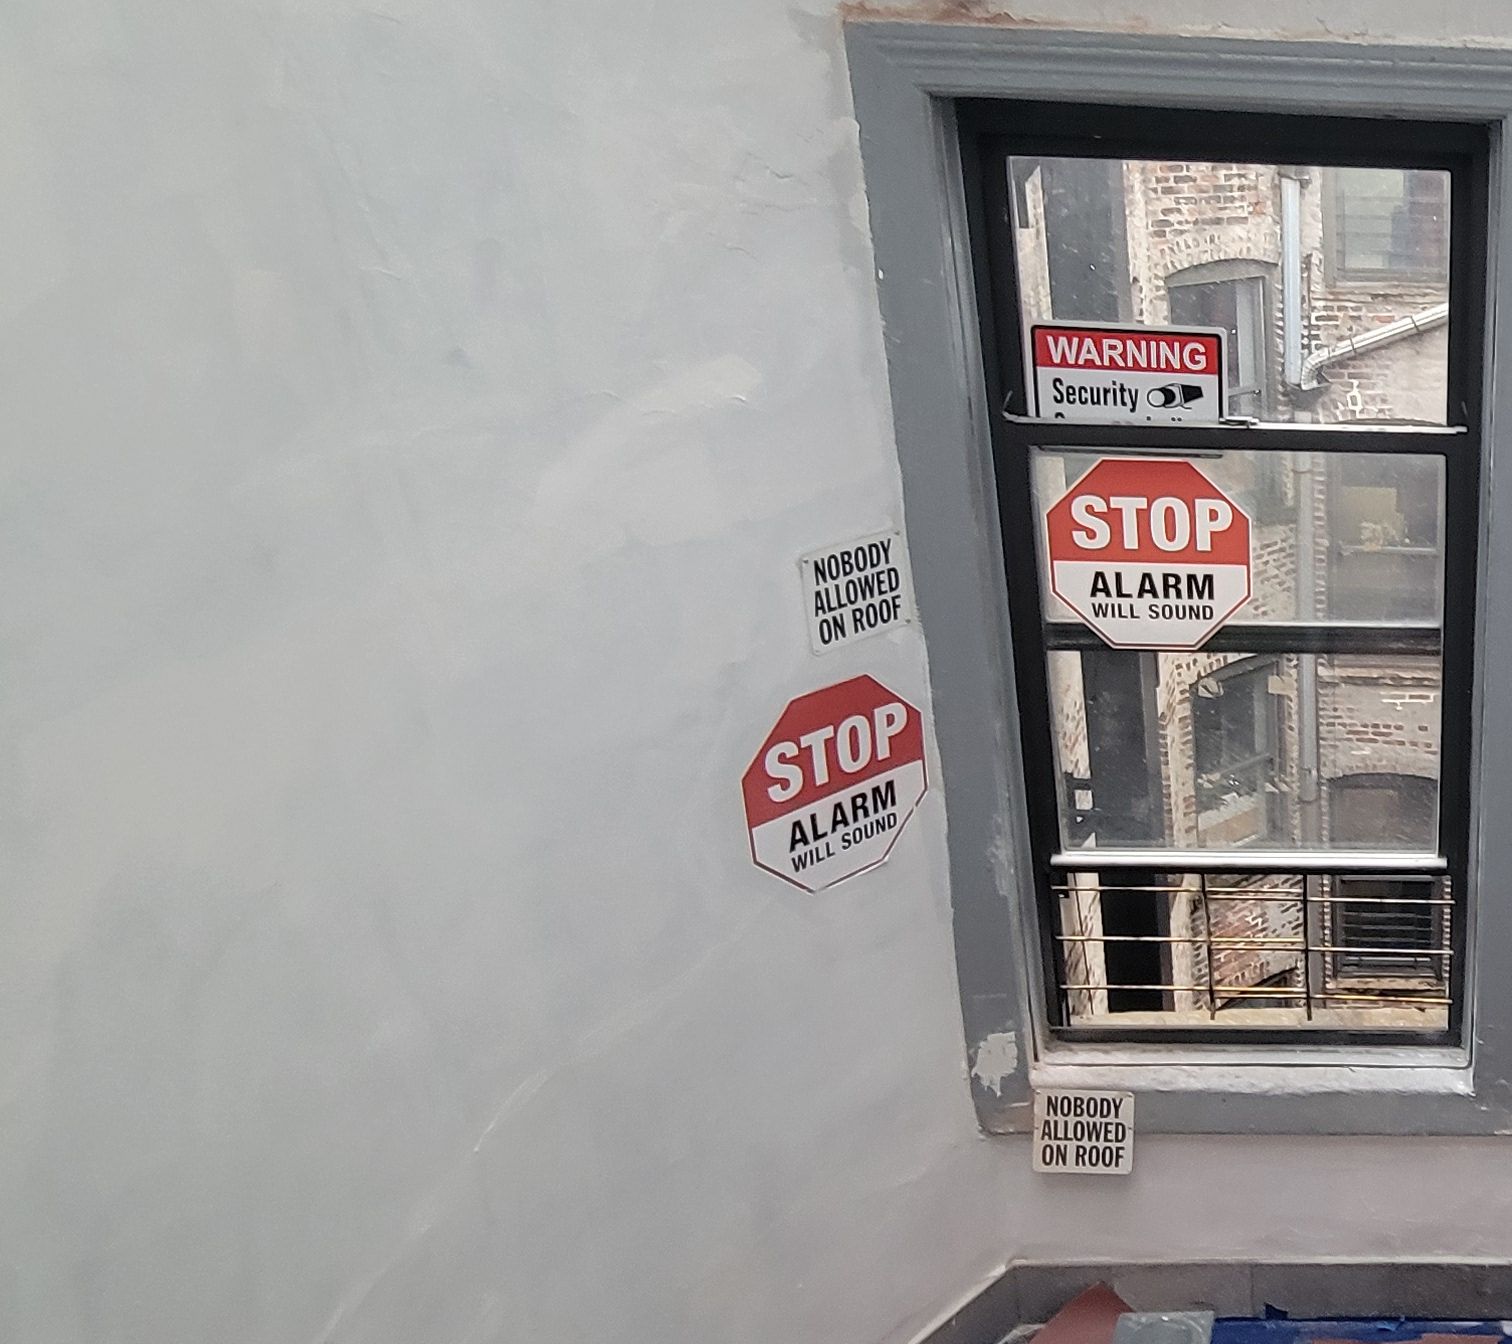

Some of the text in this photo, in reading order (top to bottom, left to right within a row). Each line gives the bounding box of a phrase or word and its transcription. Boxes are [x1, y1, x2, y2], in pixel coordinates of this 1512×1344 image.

[1046, 335, 1207, 370] WARNING
[1053, 377, 1139, 413] Security
[1070, 494, 1234, 552] STOP
[813, 537, 891, 586] NOBODY
[814, 567, 900, 617] ALLOWED
[1089, 570, 1215, 601] ALARM
[819, 594, 902, 645] ON ROOF
[1091, 602, 1214, 620] WILL SOUND
[764, 702, 908, 803] STOP
[789, 779, 897, 853] ALARM
[791, 812, 897, 873] WILL SOUND
[1046, 1095, 1123, 1119] NOBODY
[1040, 1119, 1127, 1143] ALLOWED
[1041, 1143, 1125, 1168] ON ROOF
